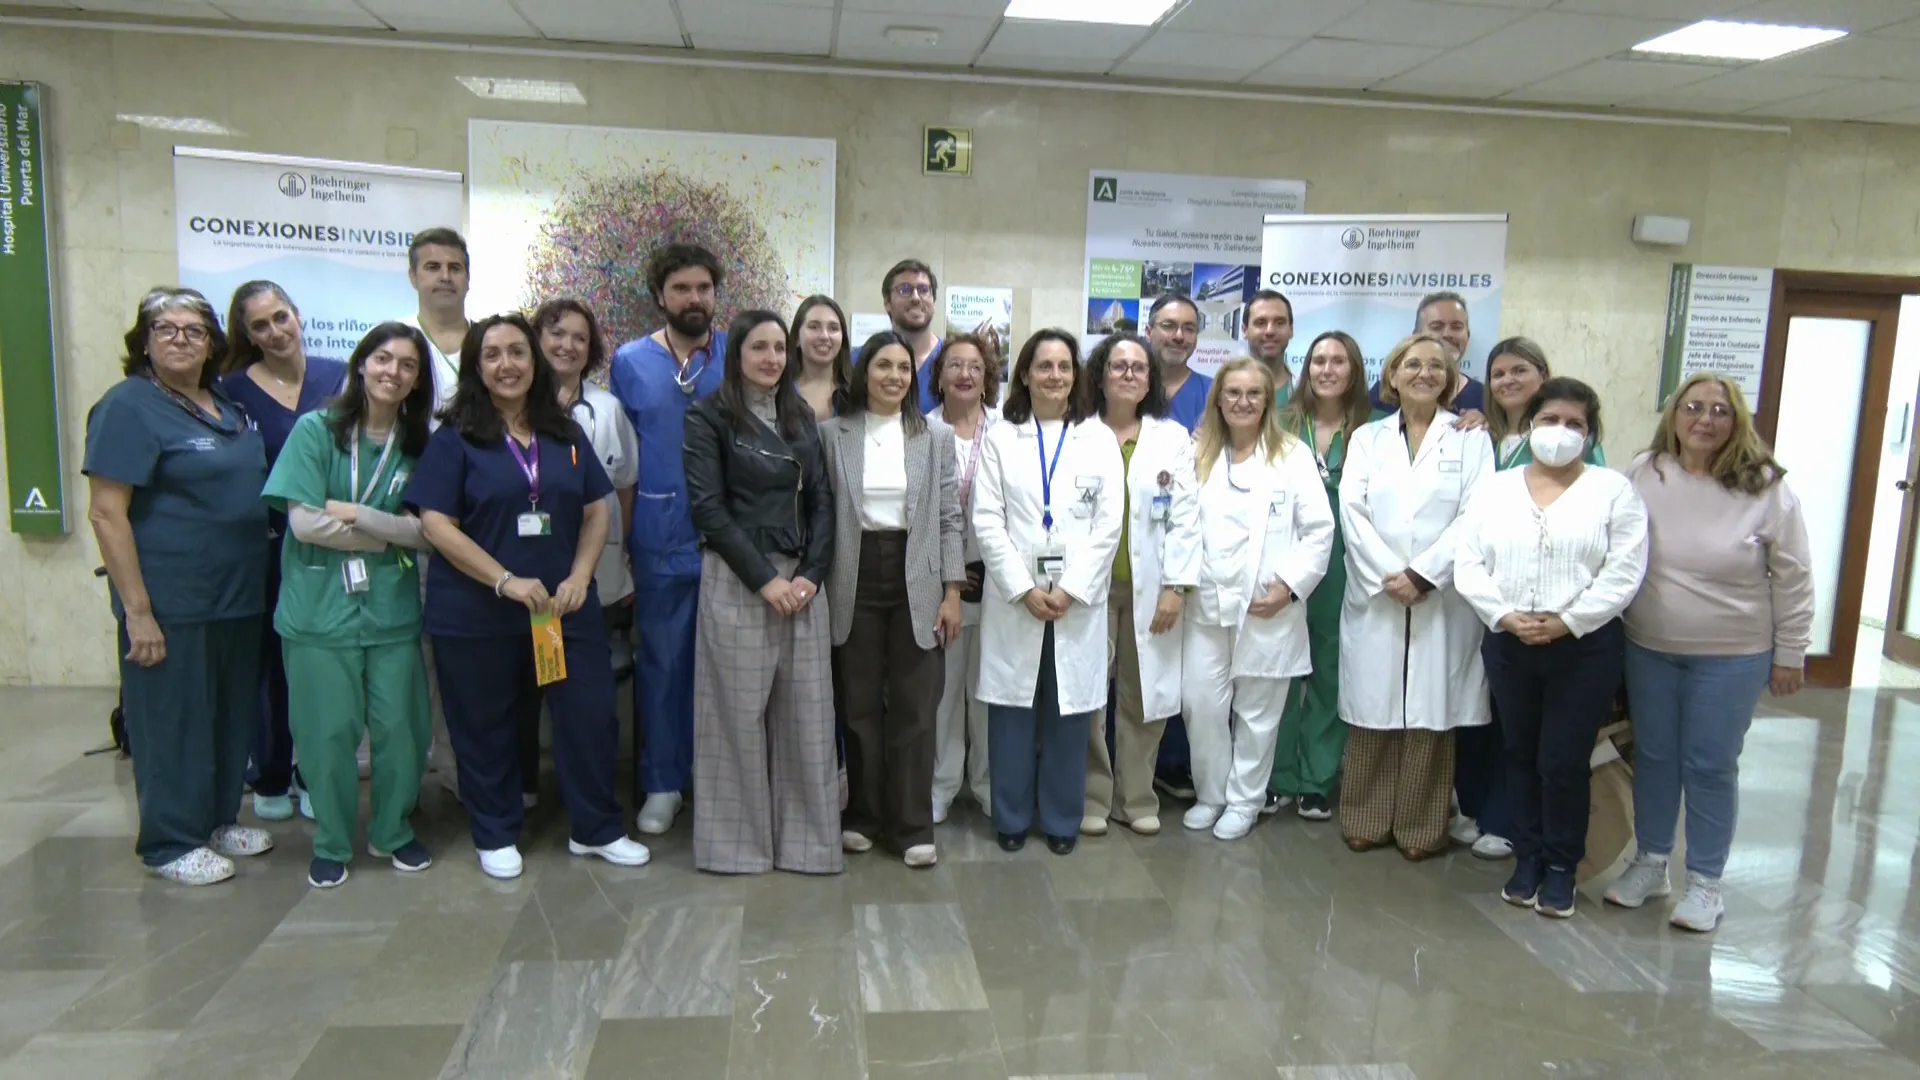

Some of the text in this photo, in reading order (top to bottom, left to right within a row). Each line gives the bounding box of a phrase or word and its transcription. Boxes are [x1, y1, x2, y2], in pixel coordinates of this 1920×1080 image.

[17, 104, 33, 206] Puerta del Mar
[310, 174, 372, 191] Boehringer
[310, 188, 366, 204] Ingelheim
[1, 196, 16, 255] Hospital
[190, 216, 416, 248] CONEXIONESINVISIB
[1145, 228, 1154, 237] Tu
[1181, 231, 1209, 239] nuestra
[1234, 232, 1243, 241] de
[1368, 227, 1421, 240] Boehringer
[1367, 239, 1415, 251] Ingelheim
[1695, 272, 1758, 281] Dirección Gerencia
[961, 294, 995, 304] símbolo
[1694, 293, 1750, 303] Dirección Médica
[951, 303, 967, 311] que
[312, 317, 334, 330] los
[339, 319, 372, 331] riño
[1691, 314, 1761, 324] Dirección de Enfermería
[1689, 331, 1728, 339] Subdirección
[1686, 361, 1707, 369] Apoyo
[1716, 361, 1754, 370] Diagnóstico
